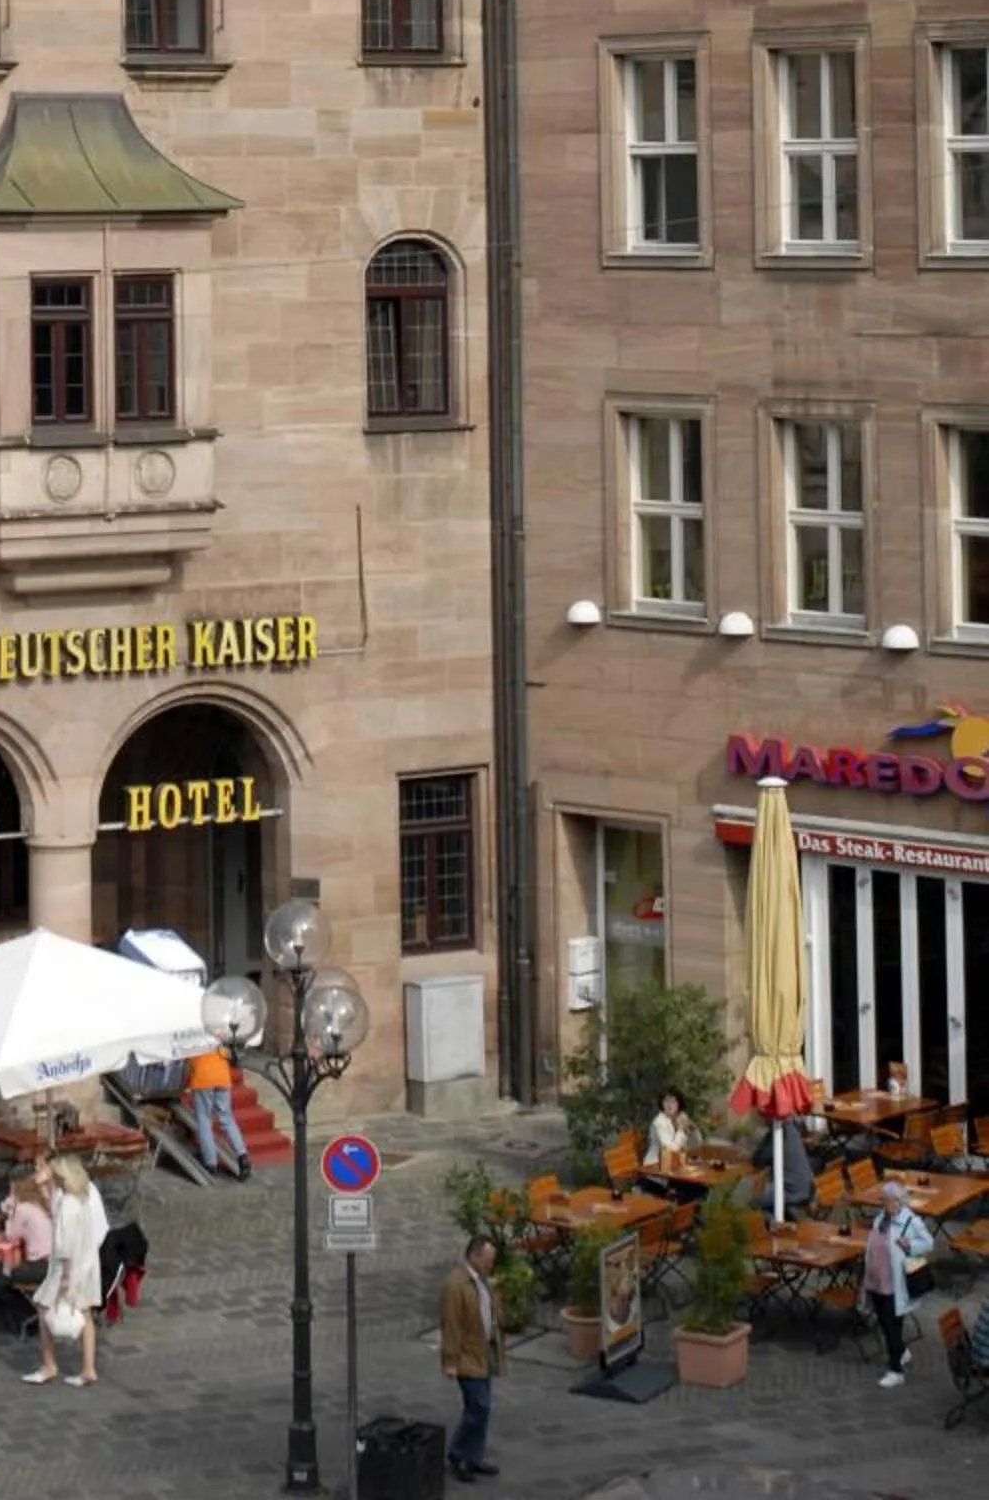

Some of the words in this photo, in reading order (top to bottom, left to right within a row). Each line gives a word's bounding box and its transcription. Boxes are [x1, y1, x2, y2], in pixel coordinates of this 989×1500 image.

[192, 615, 319, 667] KAISER
[726, 730, 989, 800] MAREDO
[126, 776, 260, 832] HOTEL
[797, 833, 830, 853] Das
[836, 836, 989, 874] Steak-Restaurant
